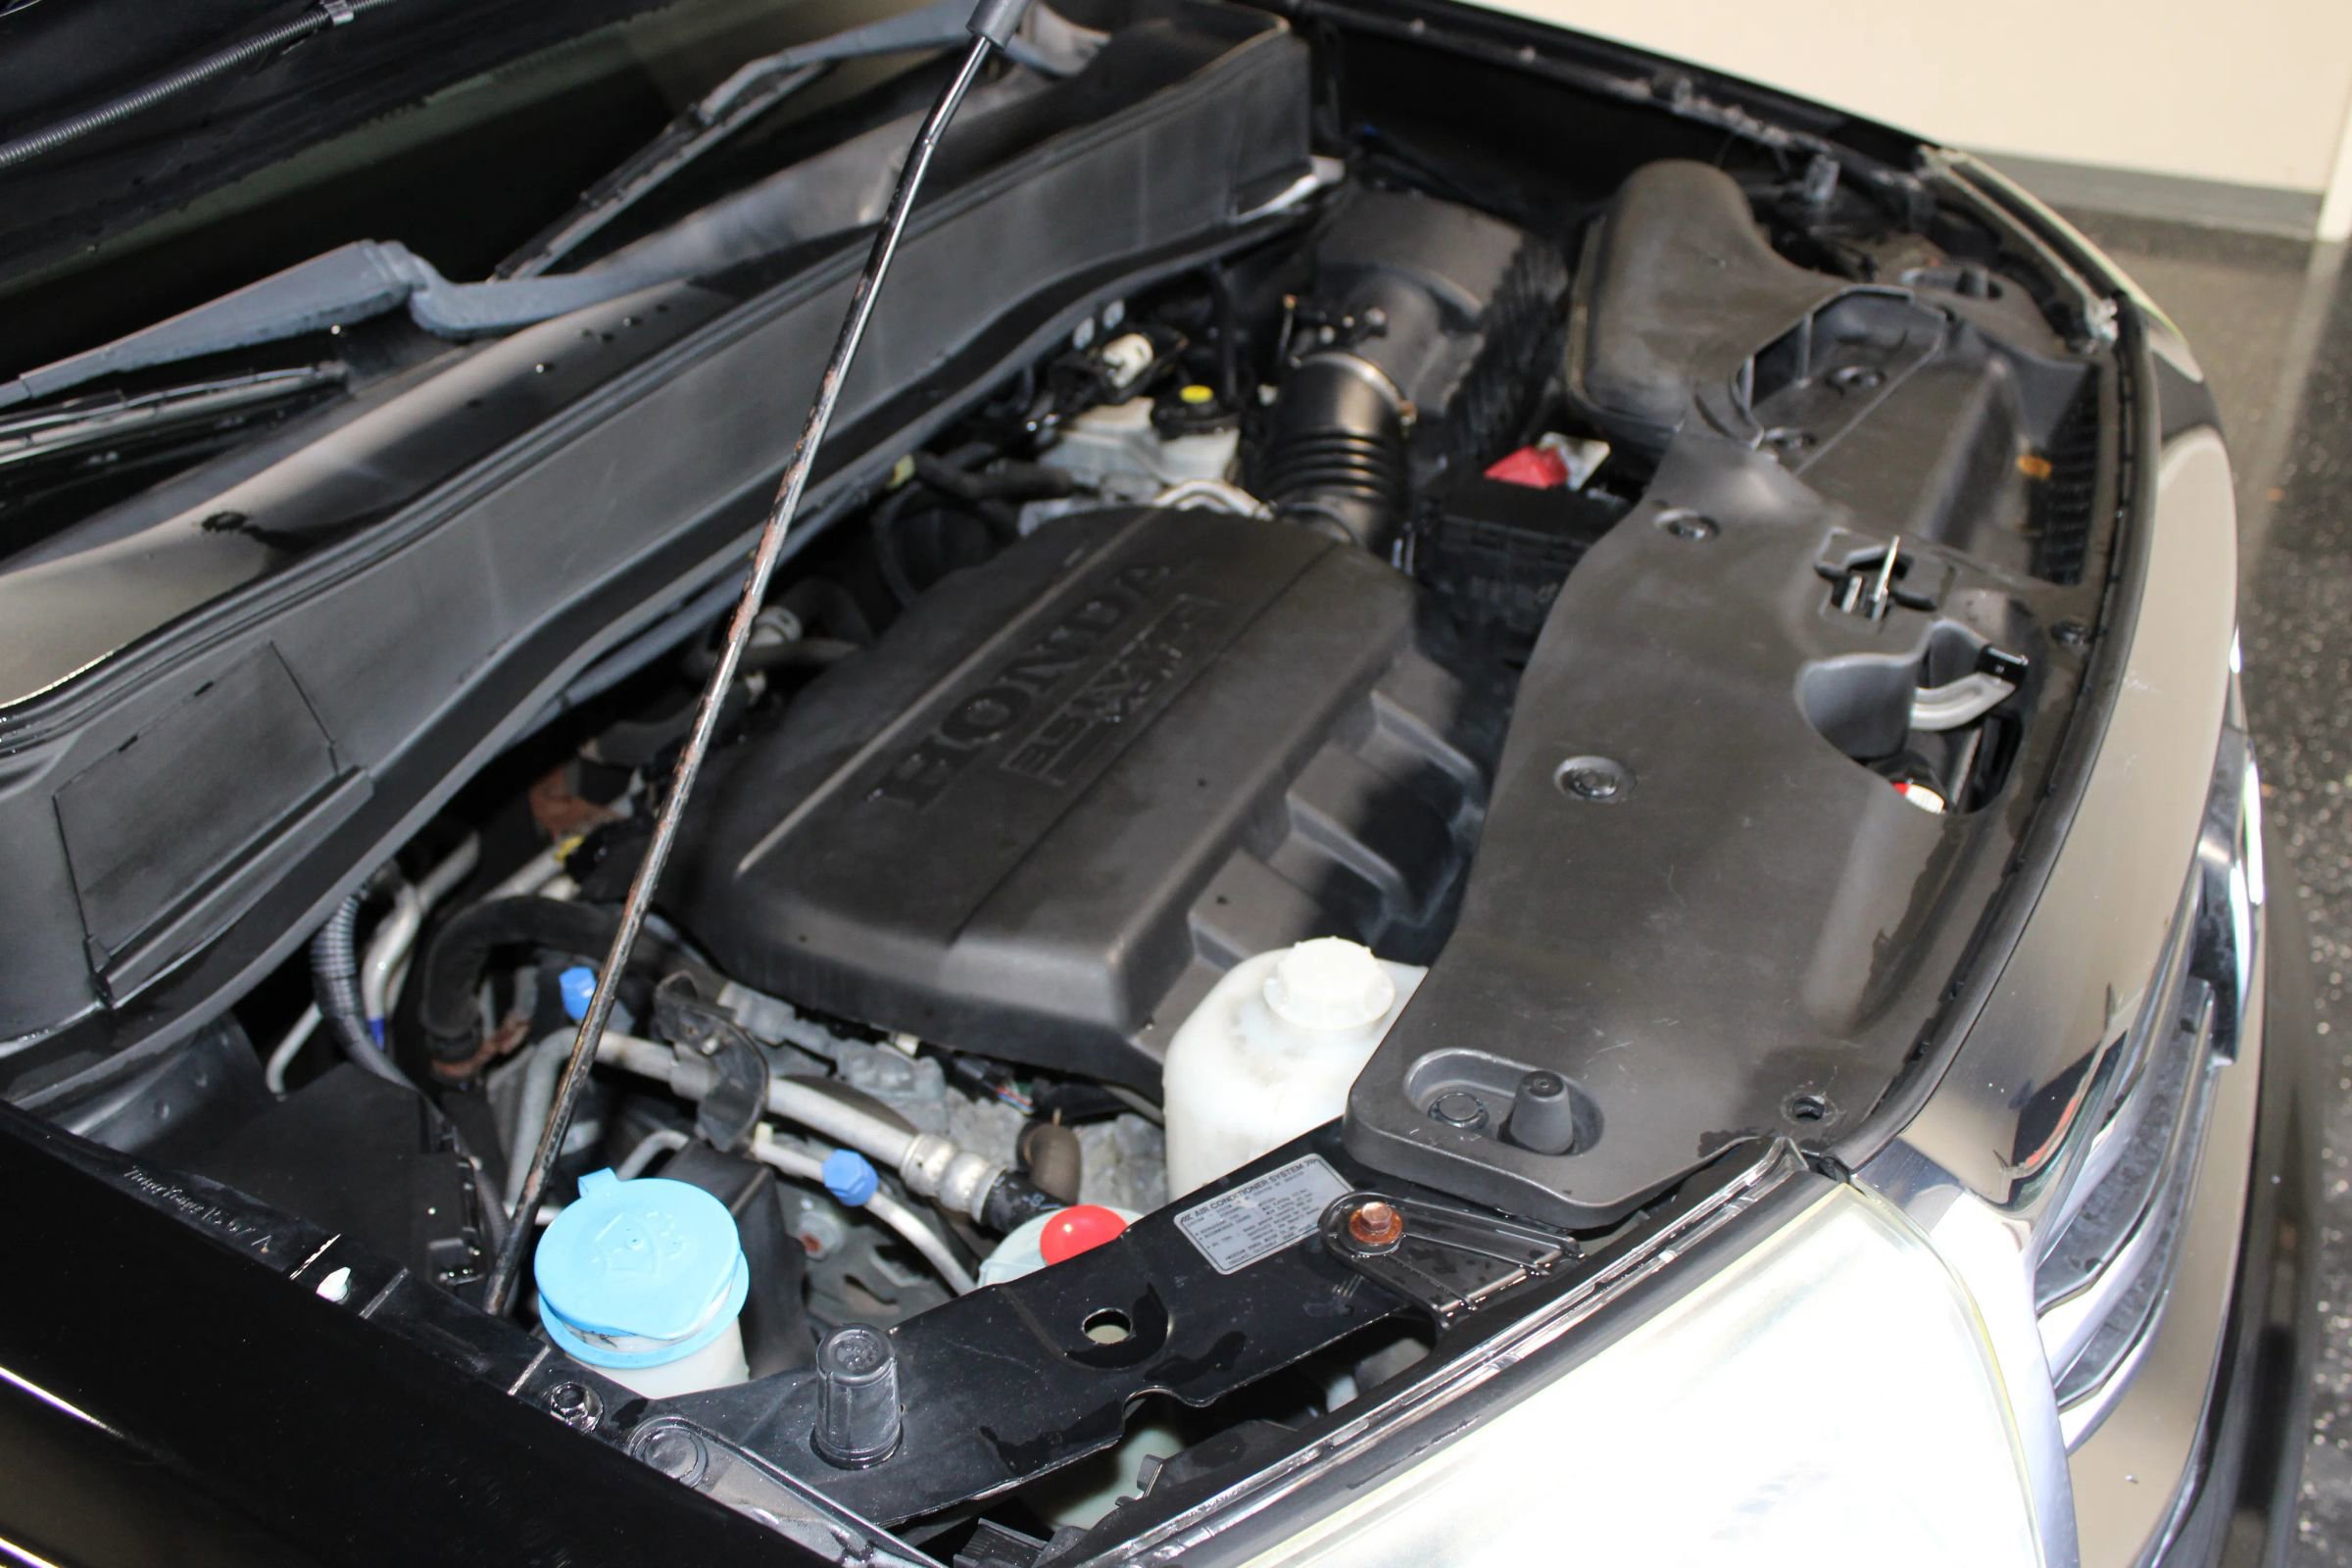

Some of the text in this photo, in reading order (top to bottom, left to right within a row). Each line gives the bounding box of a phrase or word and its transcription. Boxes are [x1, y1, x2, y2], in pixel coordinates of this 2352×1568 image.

[873, 564, 1173, 808] HONDA
[1195, 1163, 1304, 1217] AIR CONDITIONER SYSTEM
